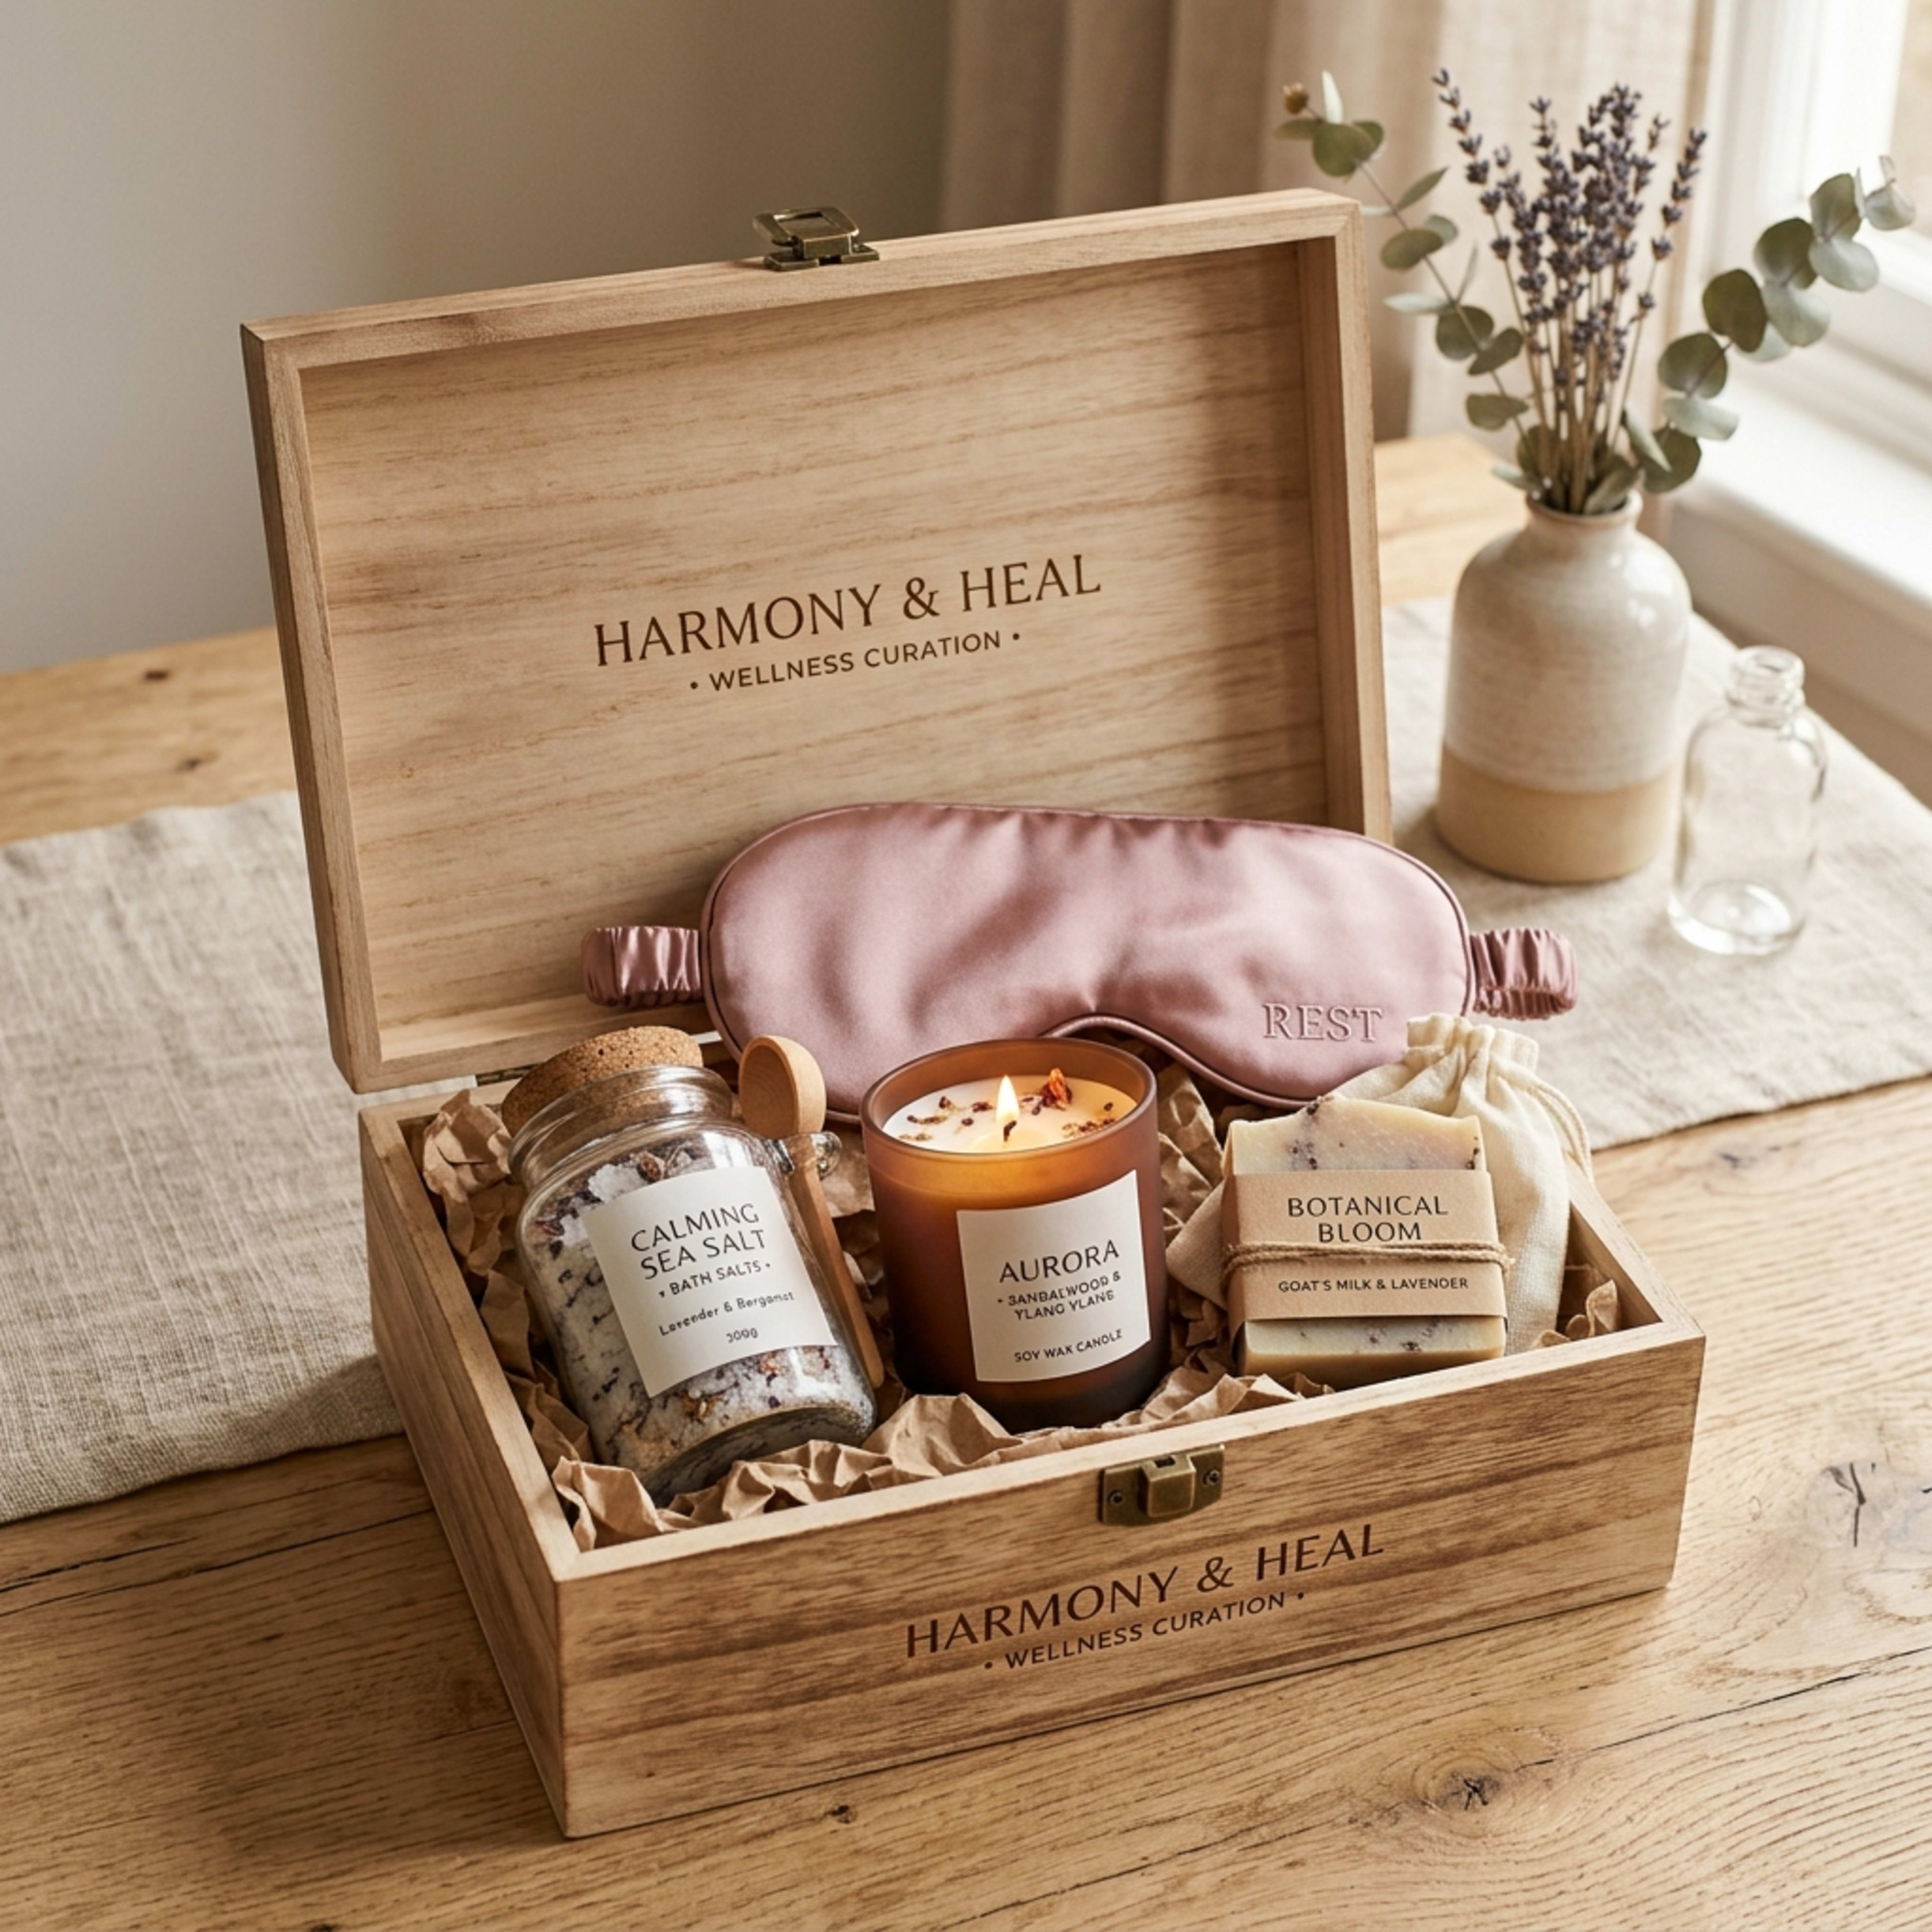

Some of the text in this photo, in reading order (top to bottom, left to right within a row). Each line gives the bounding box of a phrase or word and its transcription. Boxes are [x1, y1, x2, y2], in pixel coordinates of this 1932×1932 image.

[594, 555, 1101, 666] HARMONY & HEAL
[709, 630, 1001, 691] WELLNESS CURATION
[1262, 1003, 1383, 1042] REST
[1288, 1196, 1448, 1217] BOTANICAL
[631, 1203, 759, 1252] CALMING
[1319, 1222, 1422, 1243] BLOOM
[640, 1230, 765, 1280] SEA SALT
[999, 1240, 1119, 1283] AURORA
[670, 1260, 761, 1295] BATH SALTS
[1112, 1271, 1121, 1281] &
[1278, 1277, 1469, 1293] GOAT'S MILK & LAVENDER
[1014, 1350, 1040, 1362] SOY
[1043, 1345, 1073, 1358] WAX
[907, 1524, 1384, 1658] HARMONY & HEAL
[1005, 1592, 1284, 1669] WELLNESS CURATION
